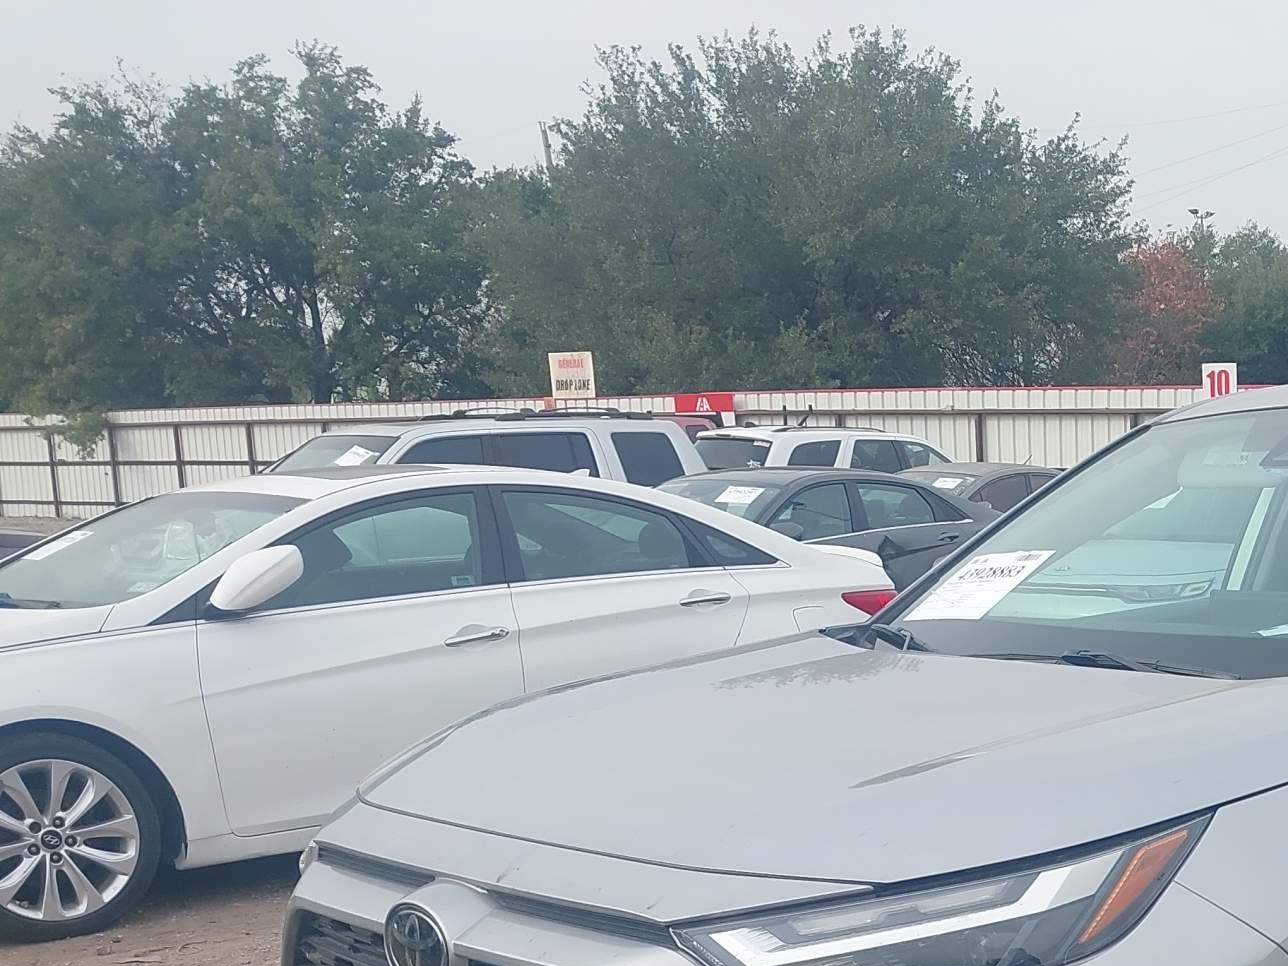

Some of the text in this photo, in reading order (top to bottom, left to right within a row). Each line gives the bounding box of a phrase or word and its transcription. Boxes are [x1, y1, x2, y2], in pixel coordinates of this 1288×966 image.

[558, 358, 585, 369] GENERAL
[555, 379, 574, 391] DROP
[1206, 369, 1230, 397] 10
